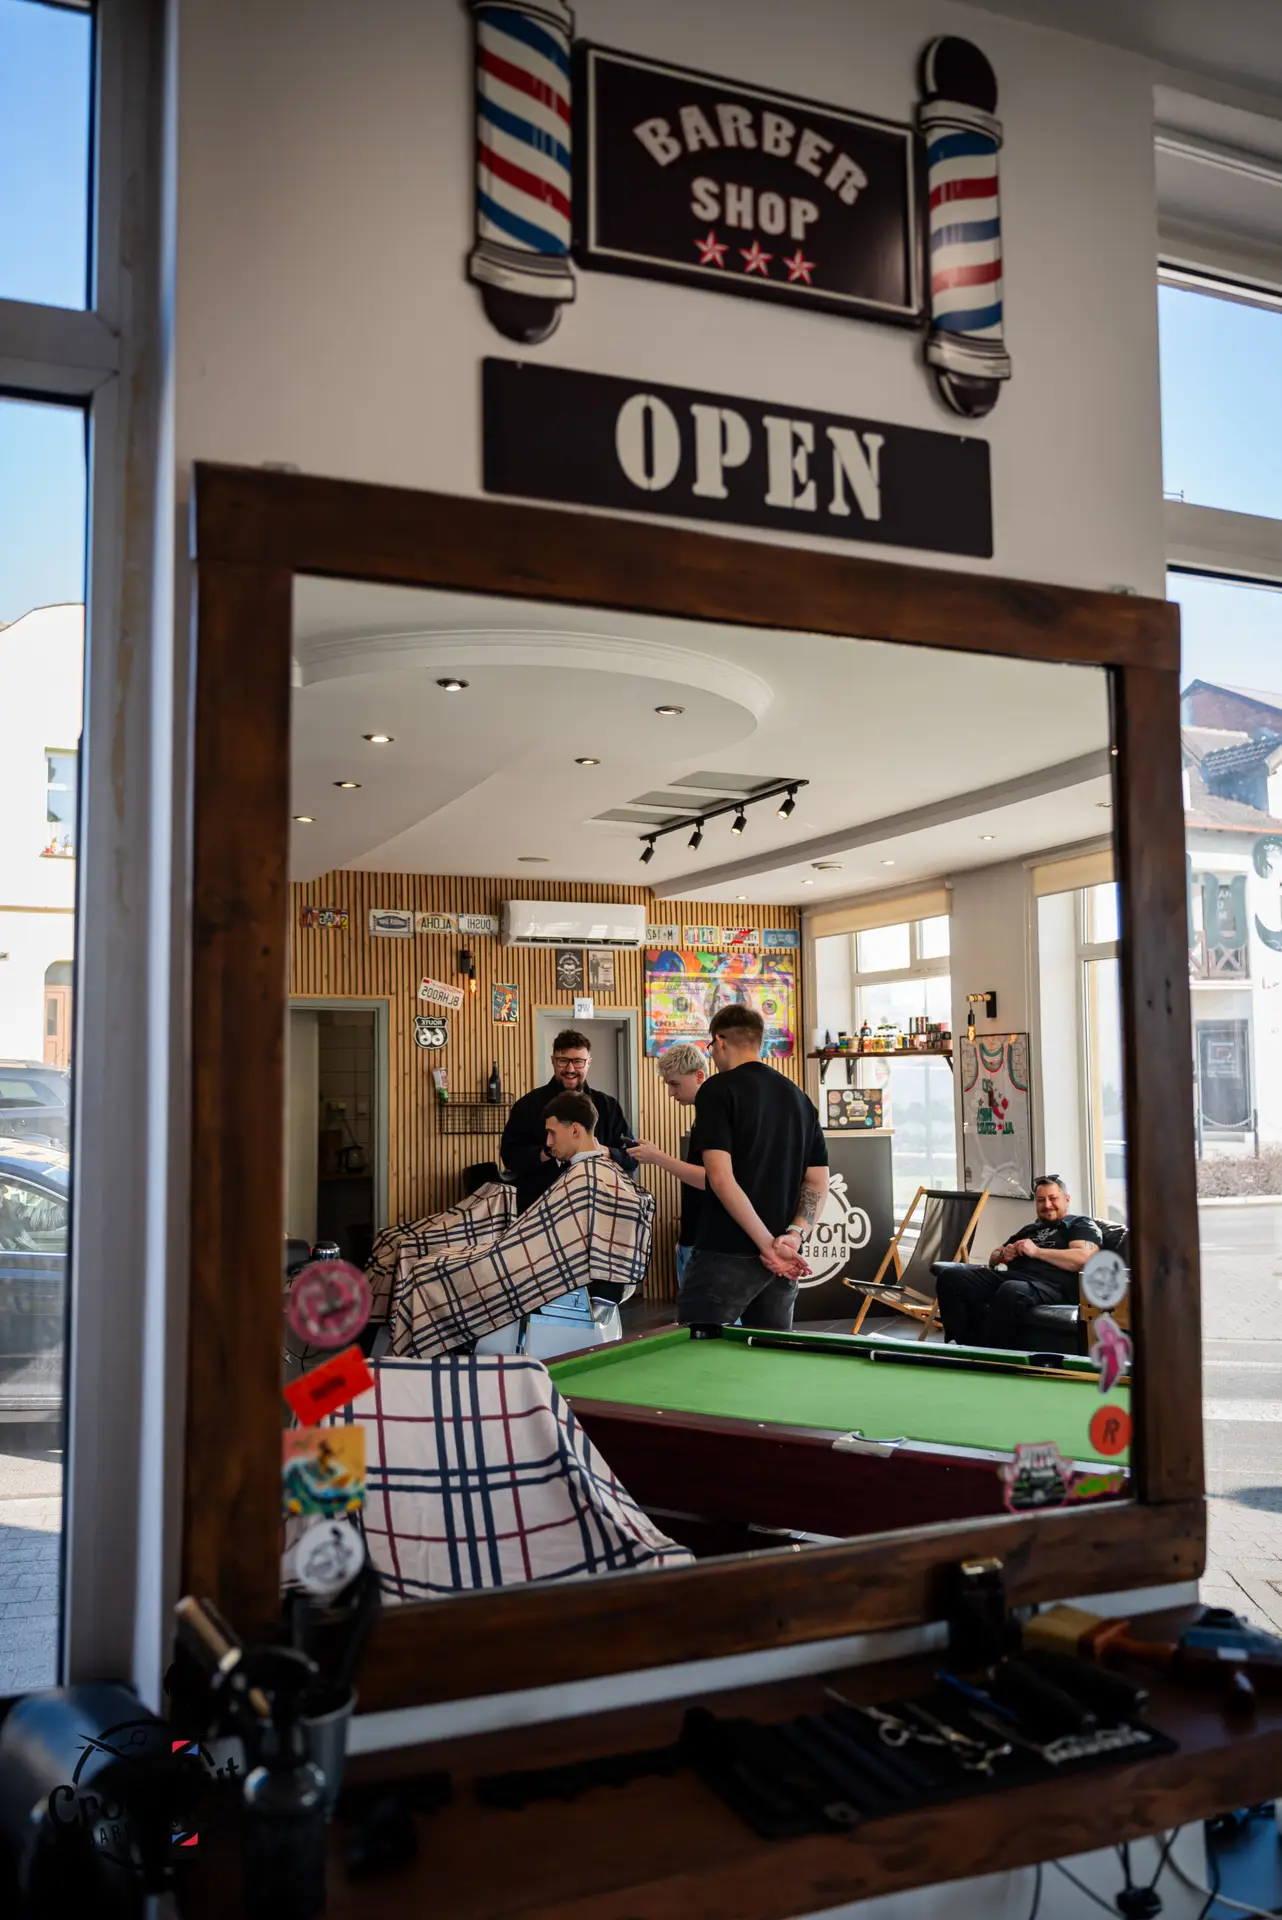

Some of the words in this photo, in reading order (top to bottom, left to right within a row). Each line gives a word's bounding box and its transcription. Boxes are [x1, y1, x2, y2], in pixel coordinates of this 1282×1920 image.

[632, 102, 869, 206] BARBER
[690, 177, 820, 241] SHOP
[615, 393, 885, 521] OPEN
